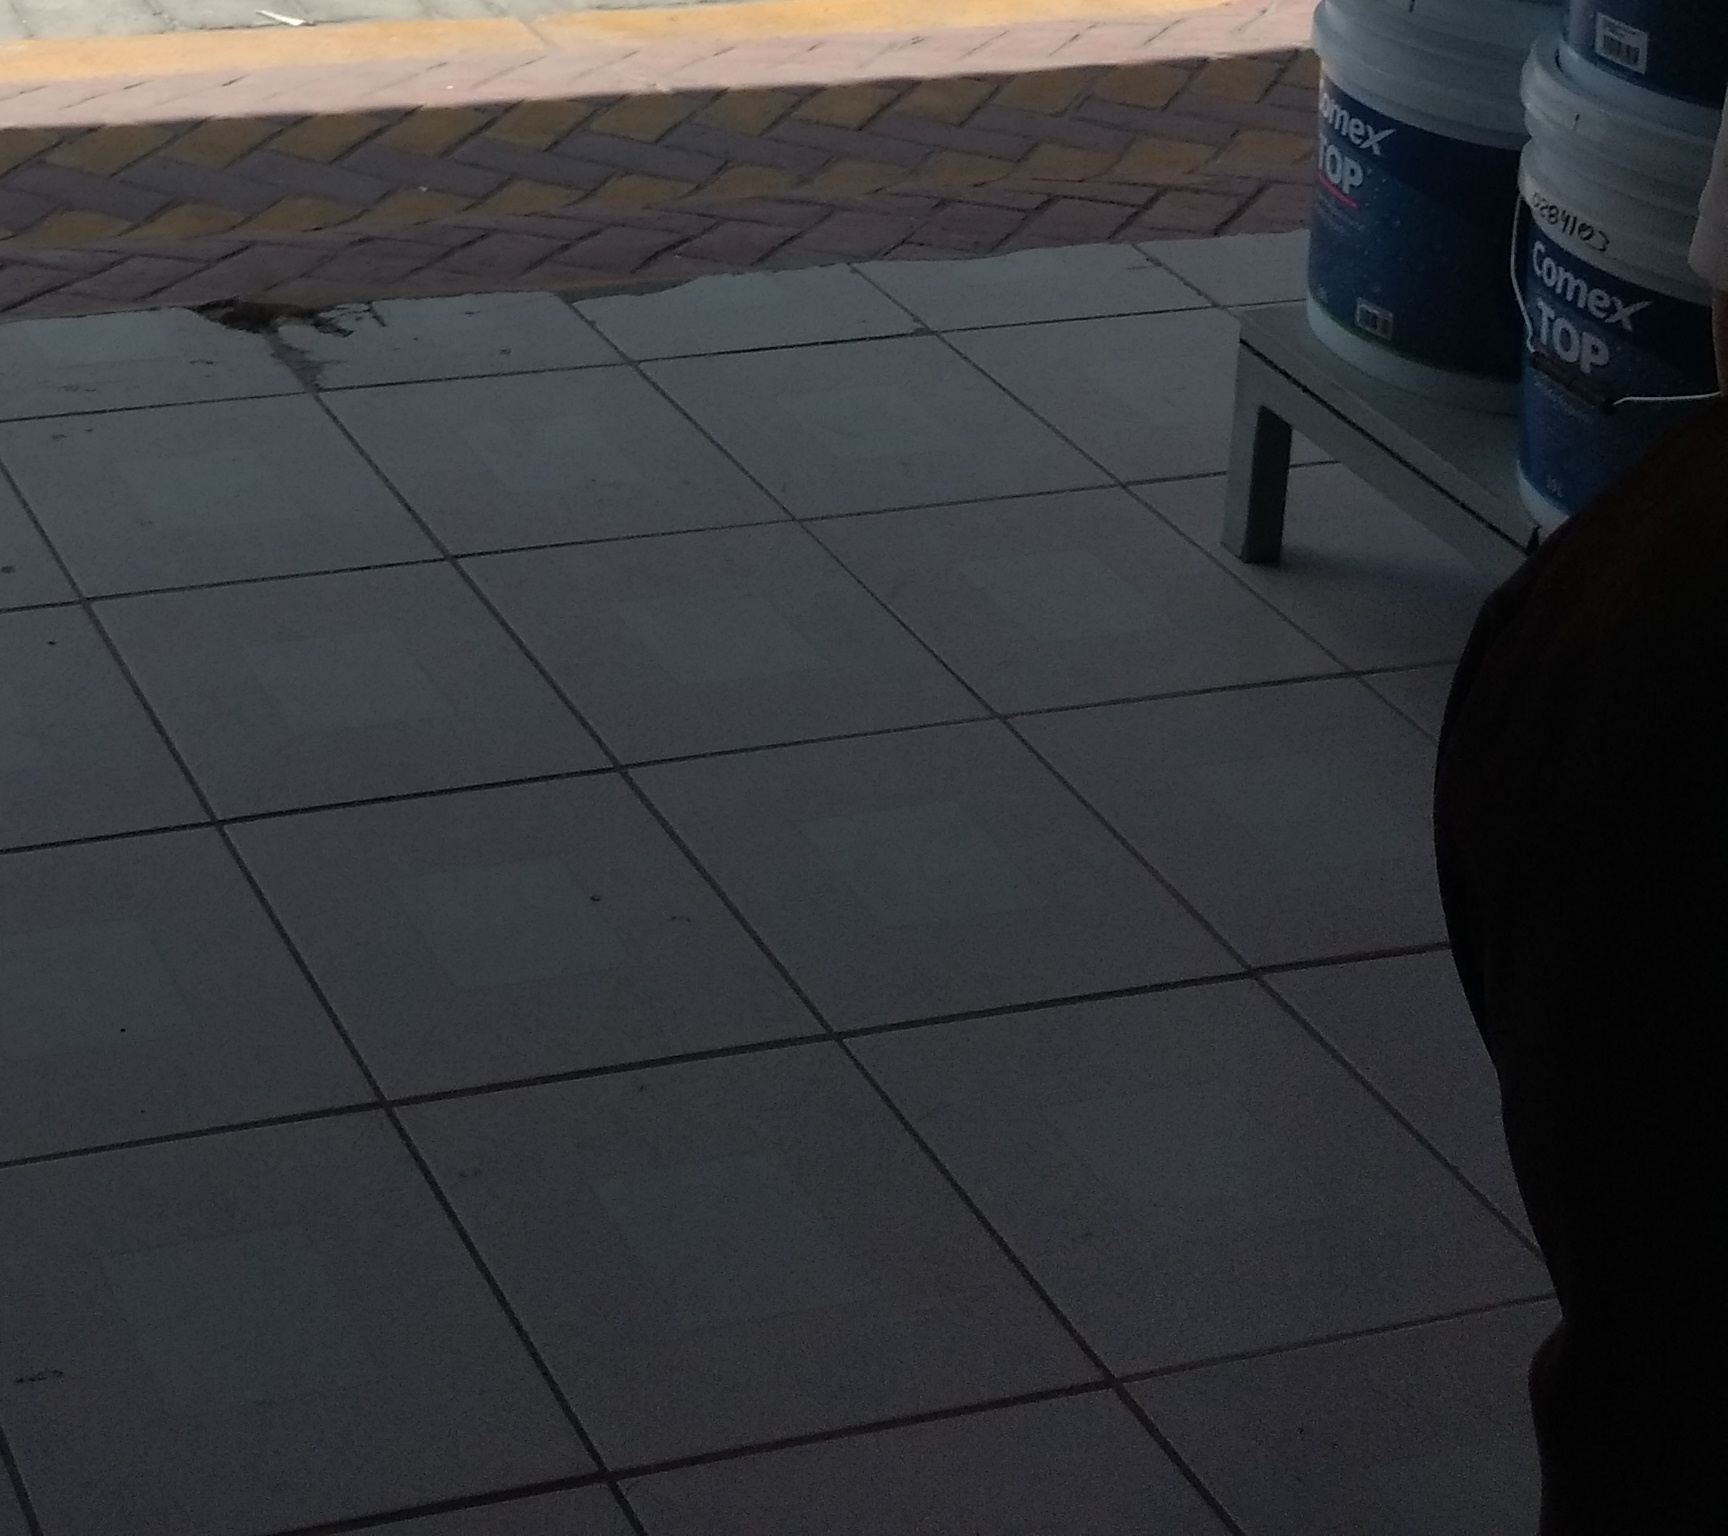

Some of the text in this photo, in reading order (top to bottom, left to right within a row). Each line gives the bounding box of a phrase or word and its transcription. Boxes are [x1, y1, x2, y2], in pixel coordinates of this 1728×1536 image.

[1319, 93, 1396, 156] omex
[1533, 240, 1653, 332] Comex
[1537, 296, 1610, 374] TOP
